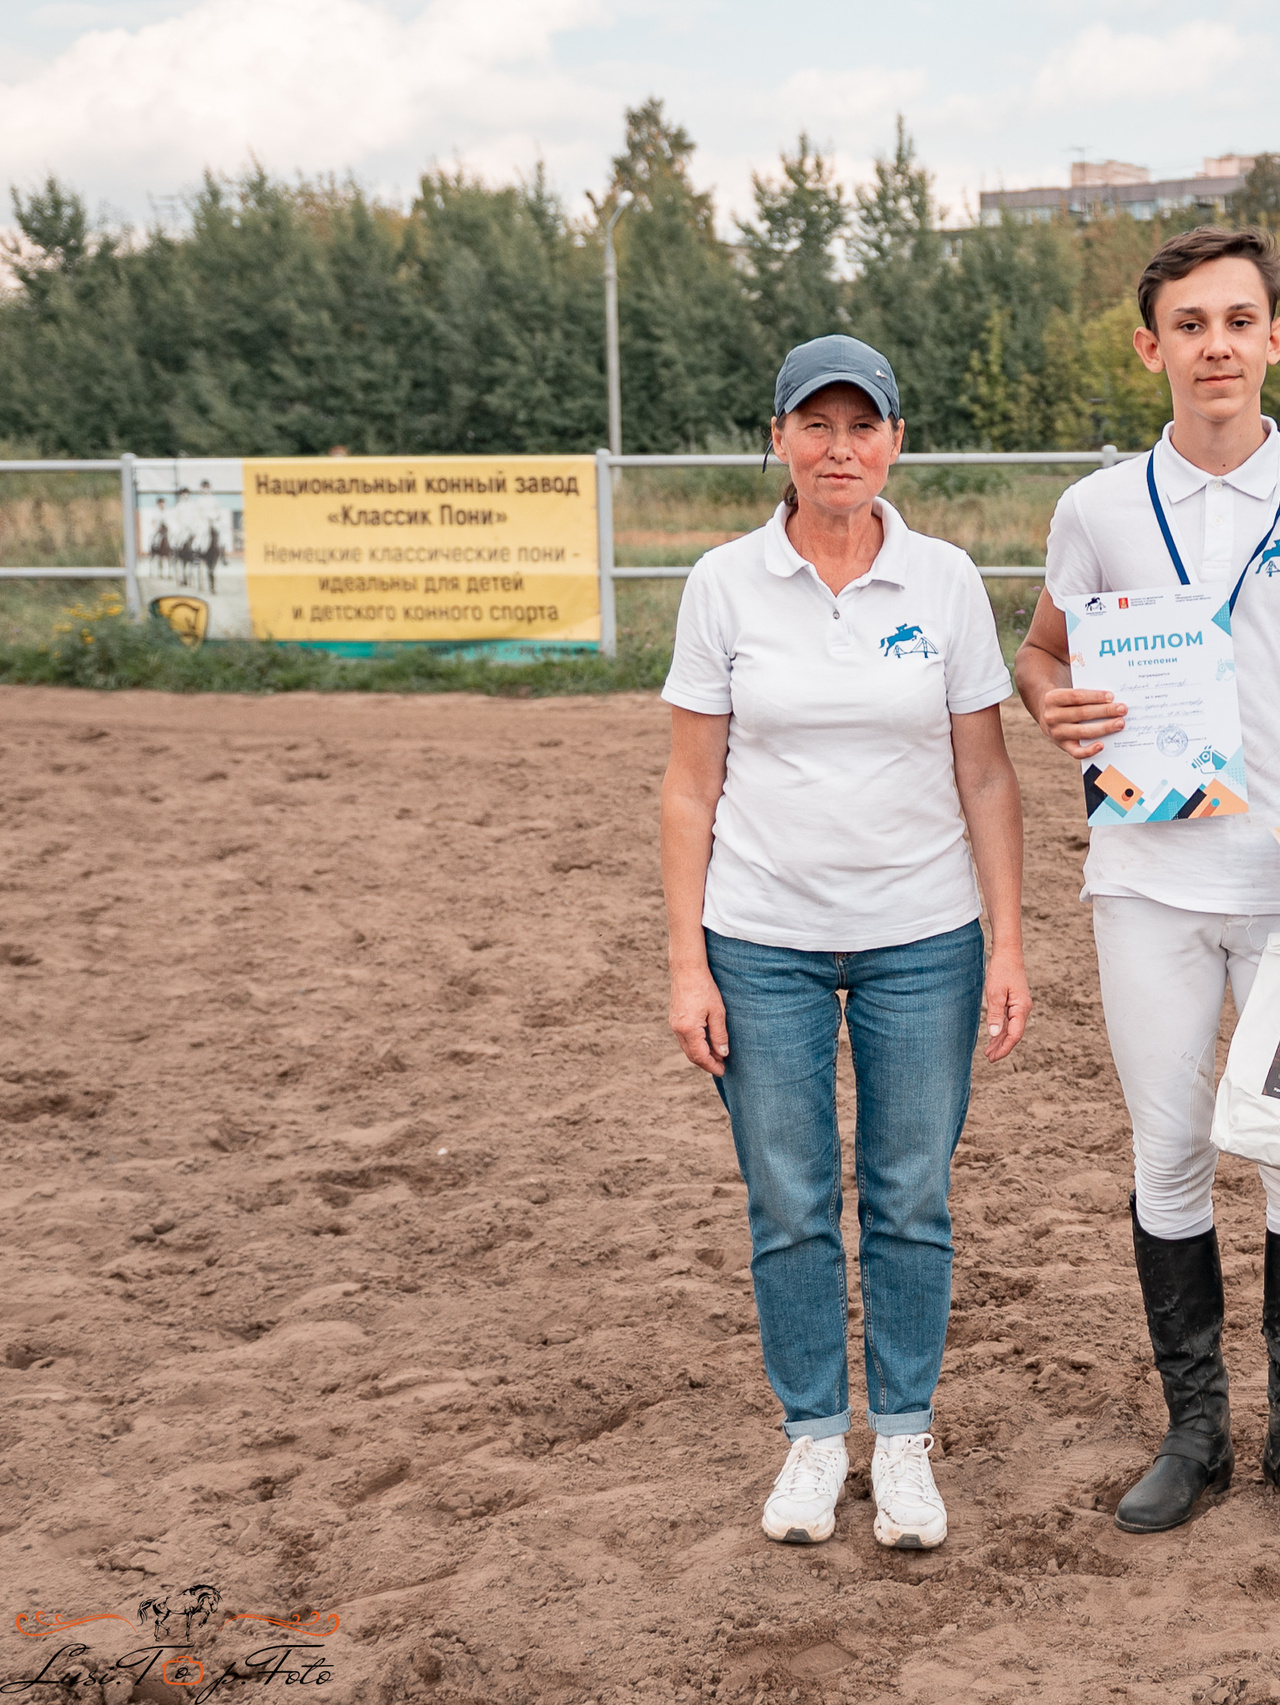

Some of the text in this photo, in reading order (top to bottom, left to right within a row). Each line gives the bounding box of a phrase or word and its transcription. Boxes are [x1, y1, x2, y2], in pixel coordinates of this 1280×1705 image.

[254, 470, 580, 496] Национальный конный завод
[327, 503, 509, 526] «Классик Пони»
[263, 541, 363, 564] Немецкие
[369, 545, 511, 563] классические
[518, 545, 566, 563] пони
[318, 571, 525, 594] идеальны для детей
[292, 604, 560, 625] и детского конного спорта
[1099, 630, 1204, 658] ДИПЛОМ
[1137, 657, 1178, 667] степени
